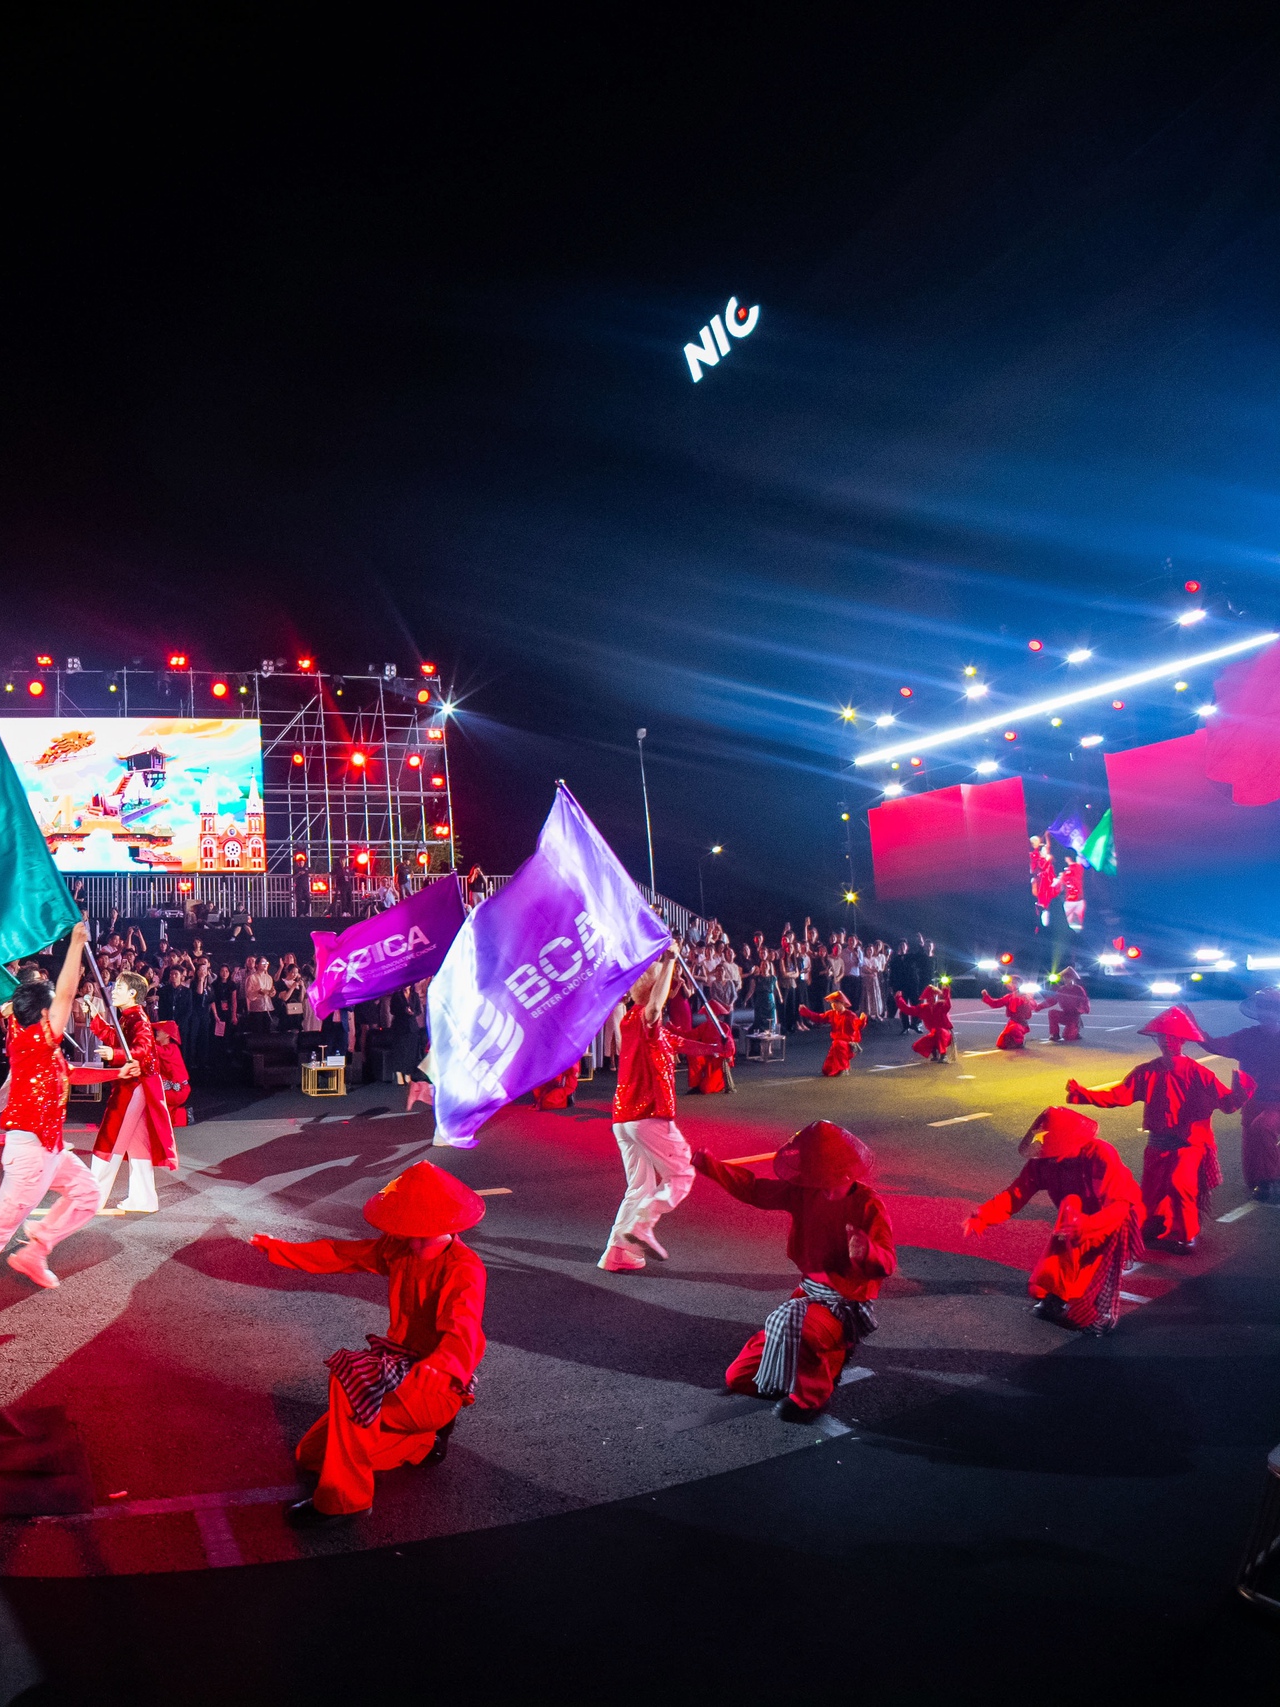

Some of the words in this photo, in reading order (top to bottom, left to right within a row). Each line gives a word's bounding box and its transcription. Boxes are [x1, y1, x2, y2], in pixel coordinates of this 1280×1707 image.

[683, 296, 759, 383] NIC
[504, 911, 613, 1010] BCA
[530, 992, 563, 1019] BETTER
[563, 970, 594, 996] CHOICE
